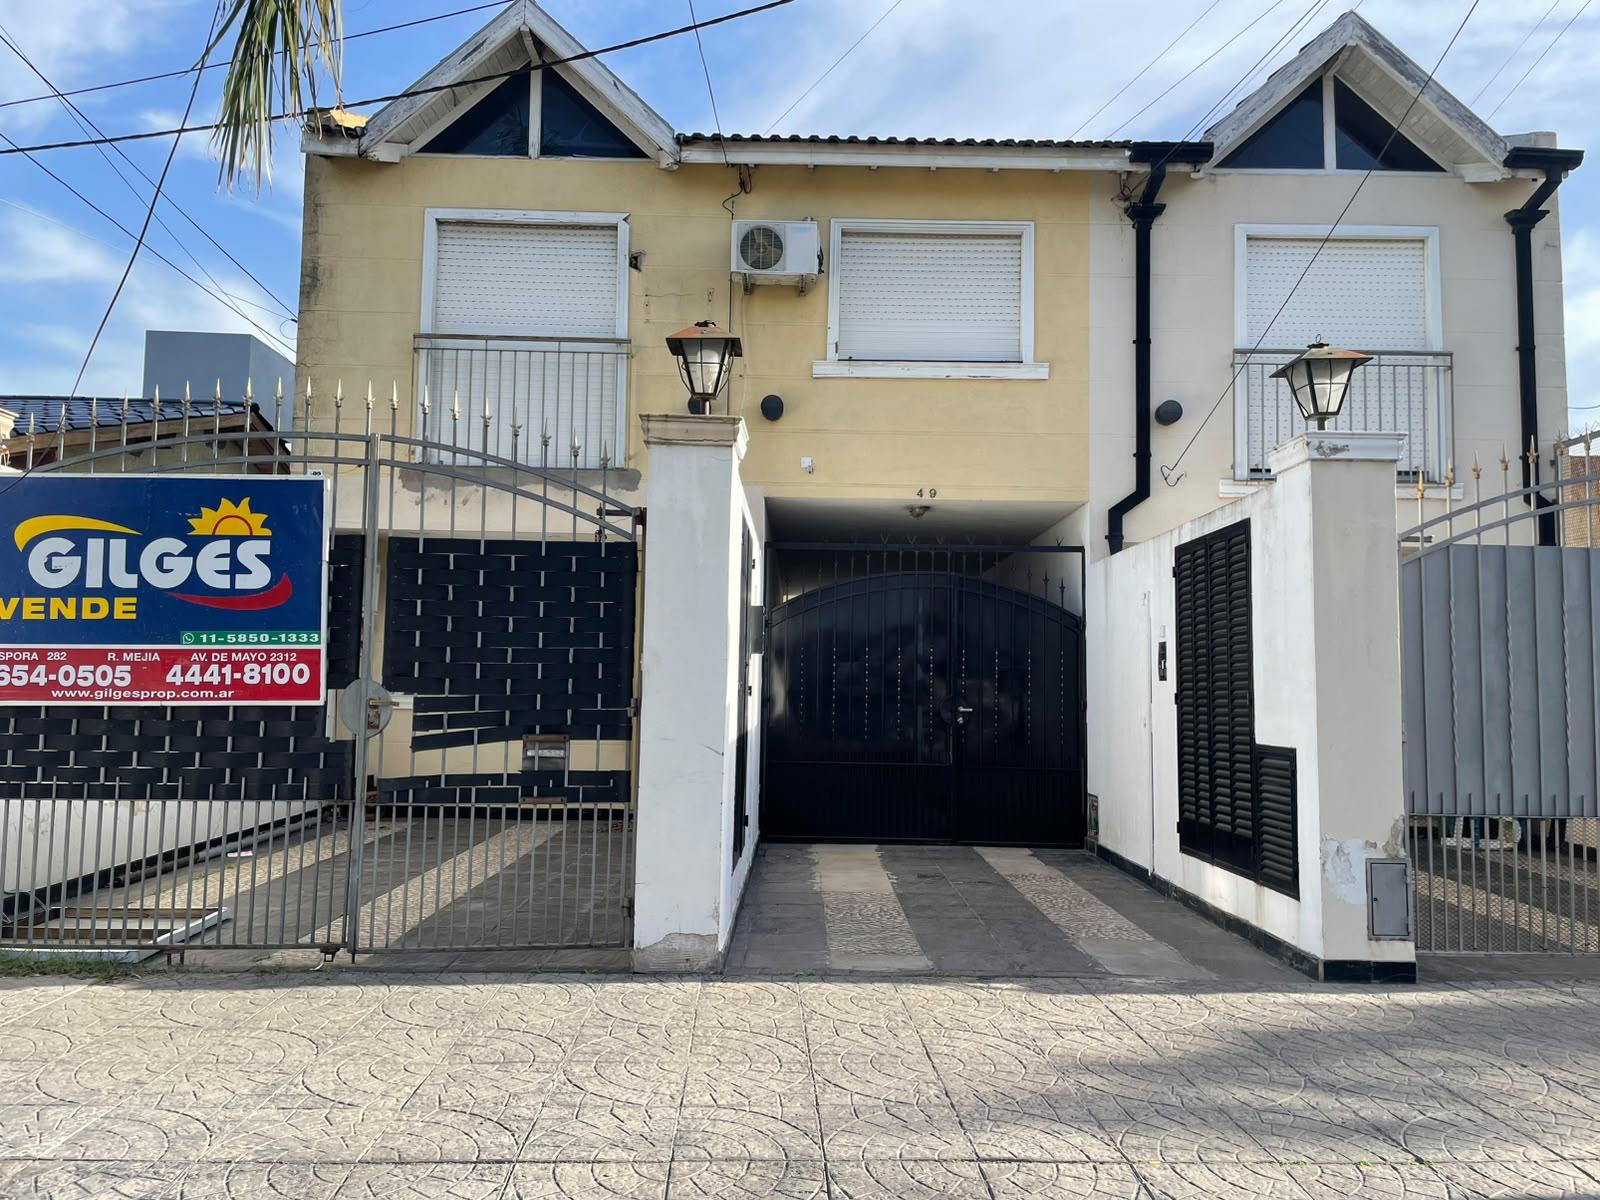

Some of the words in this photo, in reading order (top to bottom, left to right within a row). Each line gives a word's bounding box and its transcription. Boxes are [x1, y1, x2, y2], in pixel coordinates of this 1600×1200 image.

[916, 488, 937, 498] 49
[27, 537, 272, 590] GILGES
[0, 597, 137, 620] VENDE
[200, 633, 319, 643] 11-5850-1333
[47, 652, 67, 661] 282
[107, 652, 119, 662] R.
[123, 652, 160, 662] MEJIA
[190, 652, 208, 662] AV.
[211, 652, 228, 662] DE
[231, 652, 267, 662] MAYO
[270, 652, 297, 662] 2312
[165, 662, 311, 686] 4441-8100
[51, 688, 235, 700] www.gilgesprop.com.ar
